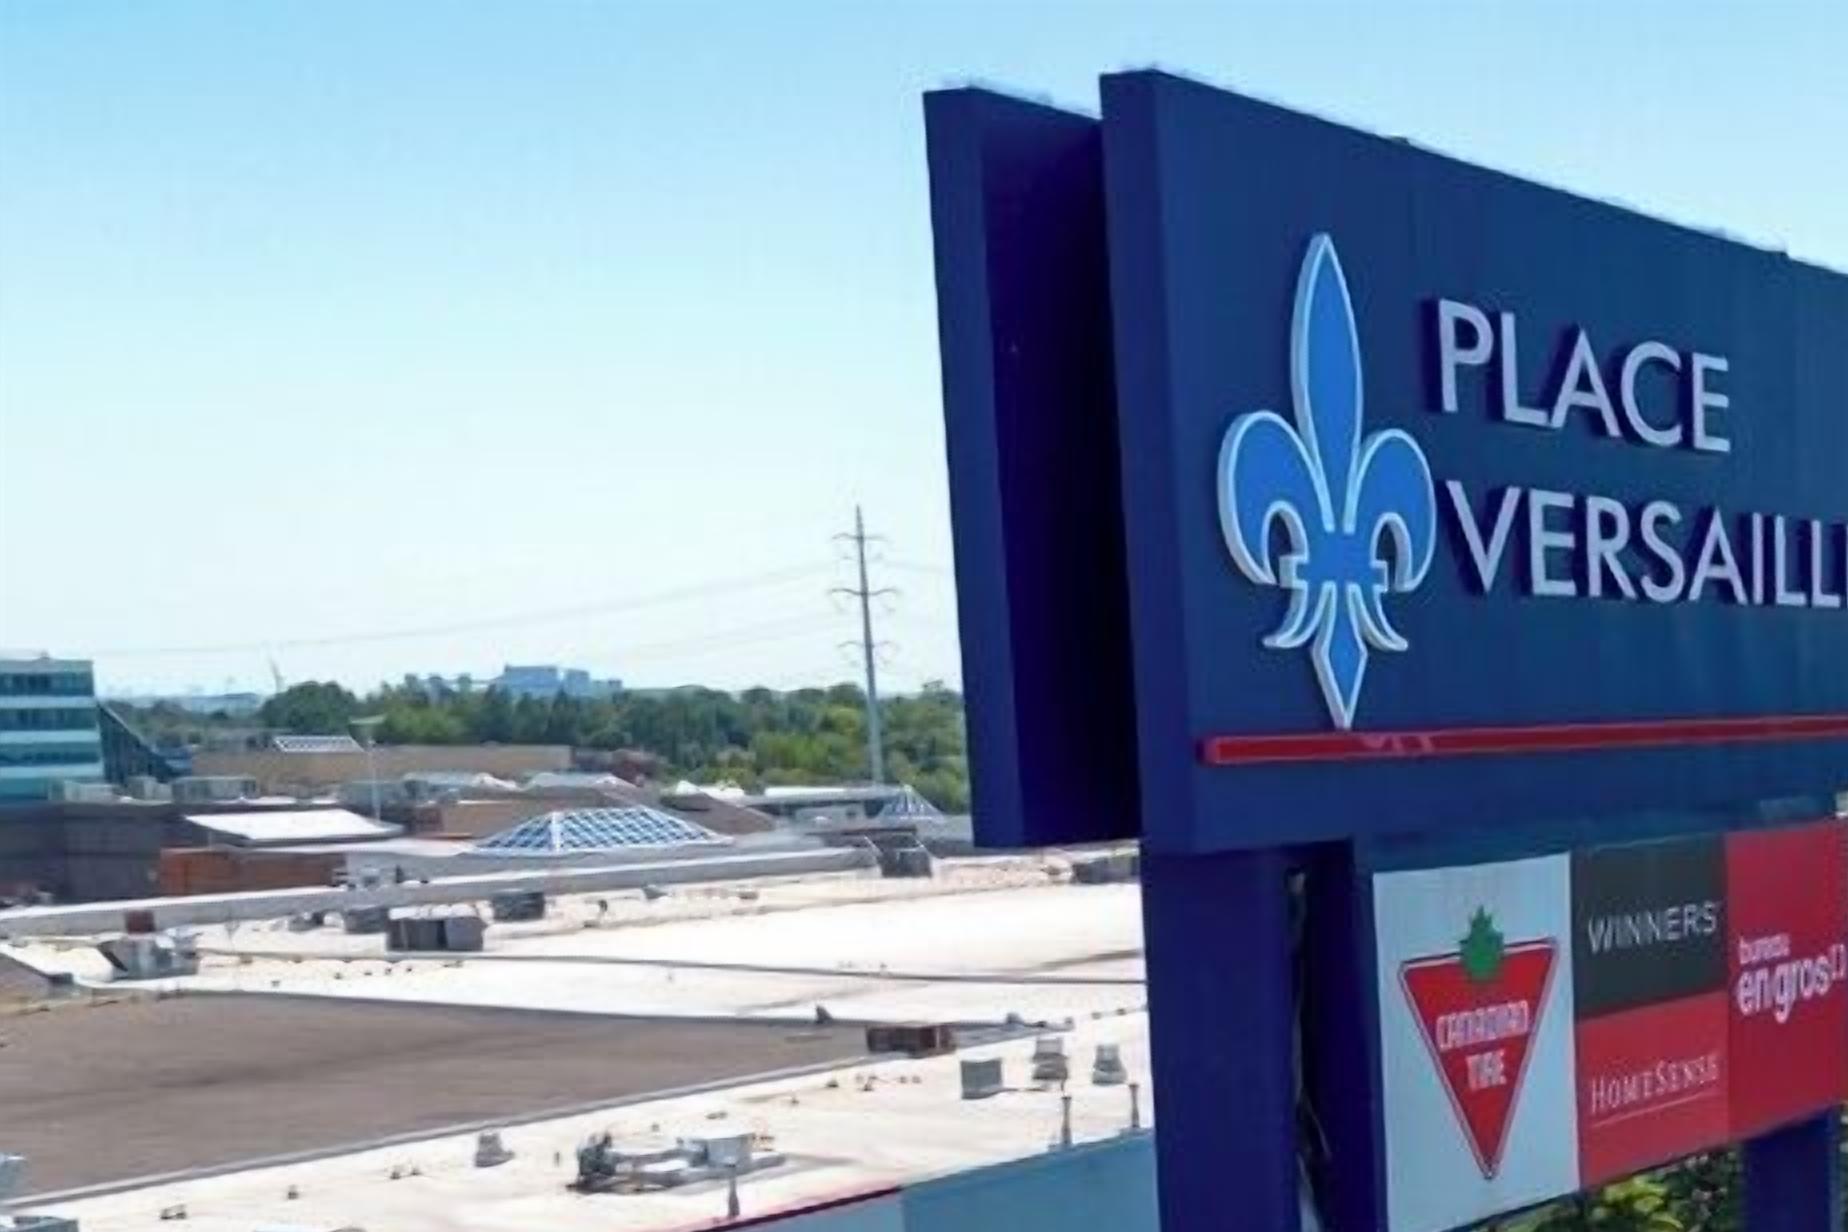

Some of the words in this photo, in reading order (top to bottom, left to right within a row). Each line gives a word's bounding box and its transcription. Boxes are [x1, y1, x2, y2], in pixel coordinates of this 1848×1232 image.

[1438, 298, 1731, 453] PLACE
[1588, 901, 1718, 954] WINNERS
[1465, 1048, 1508, 1093] TIRE
